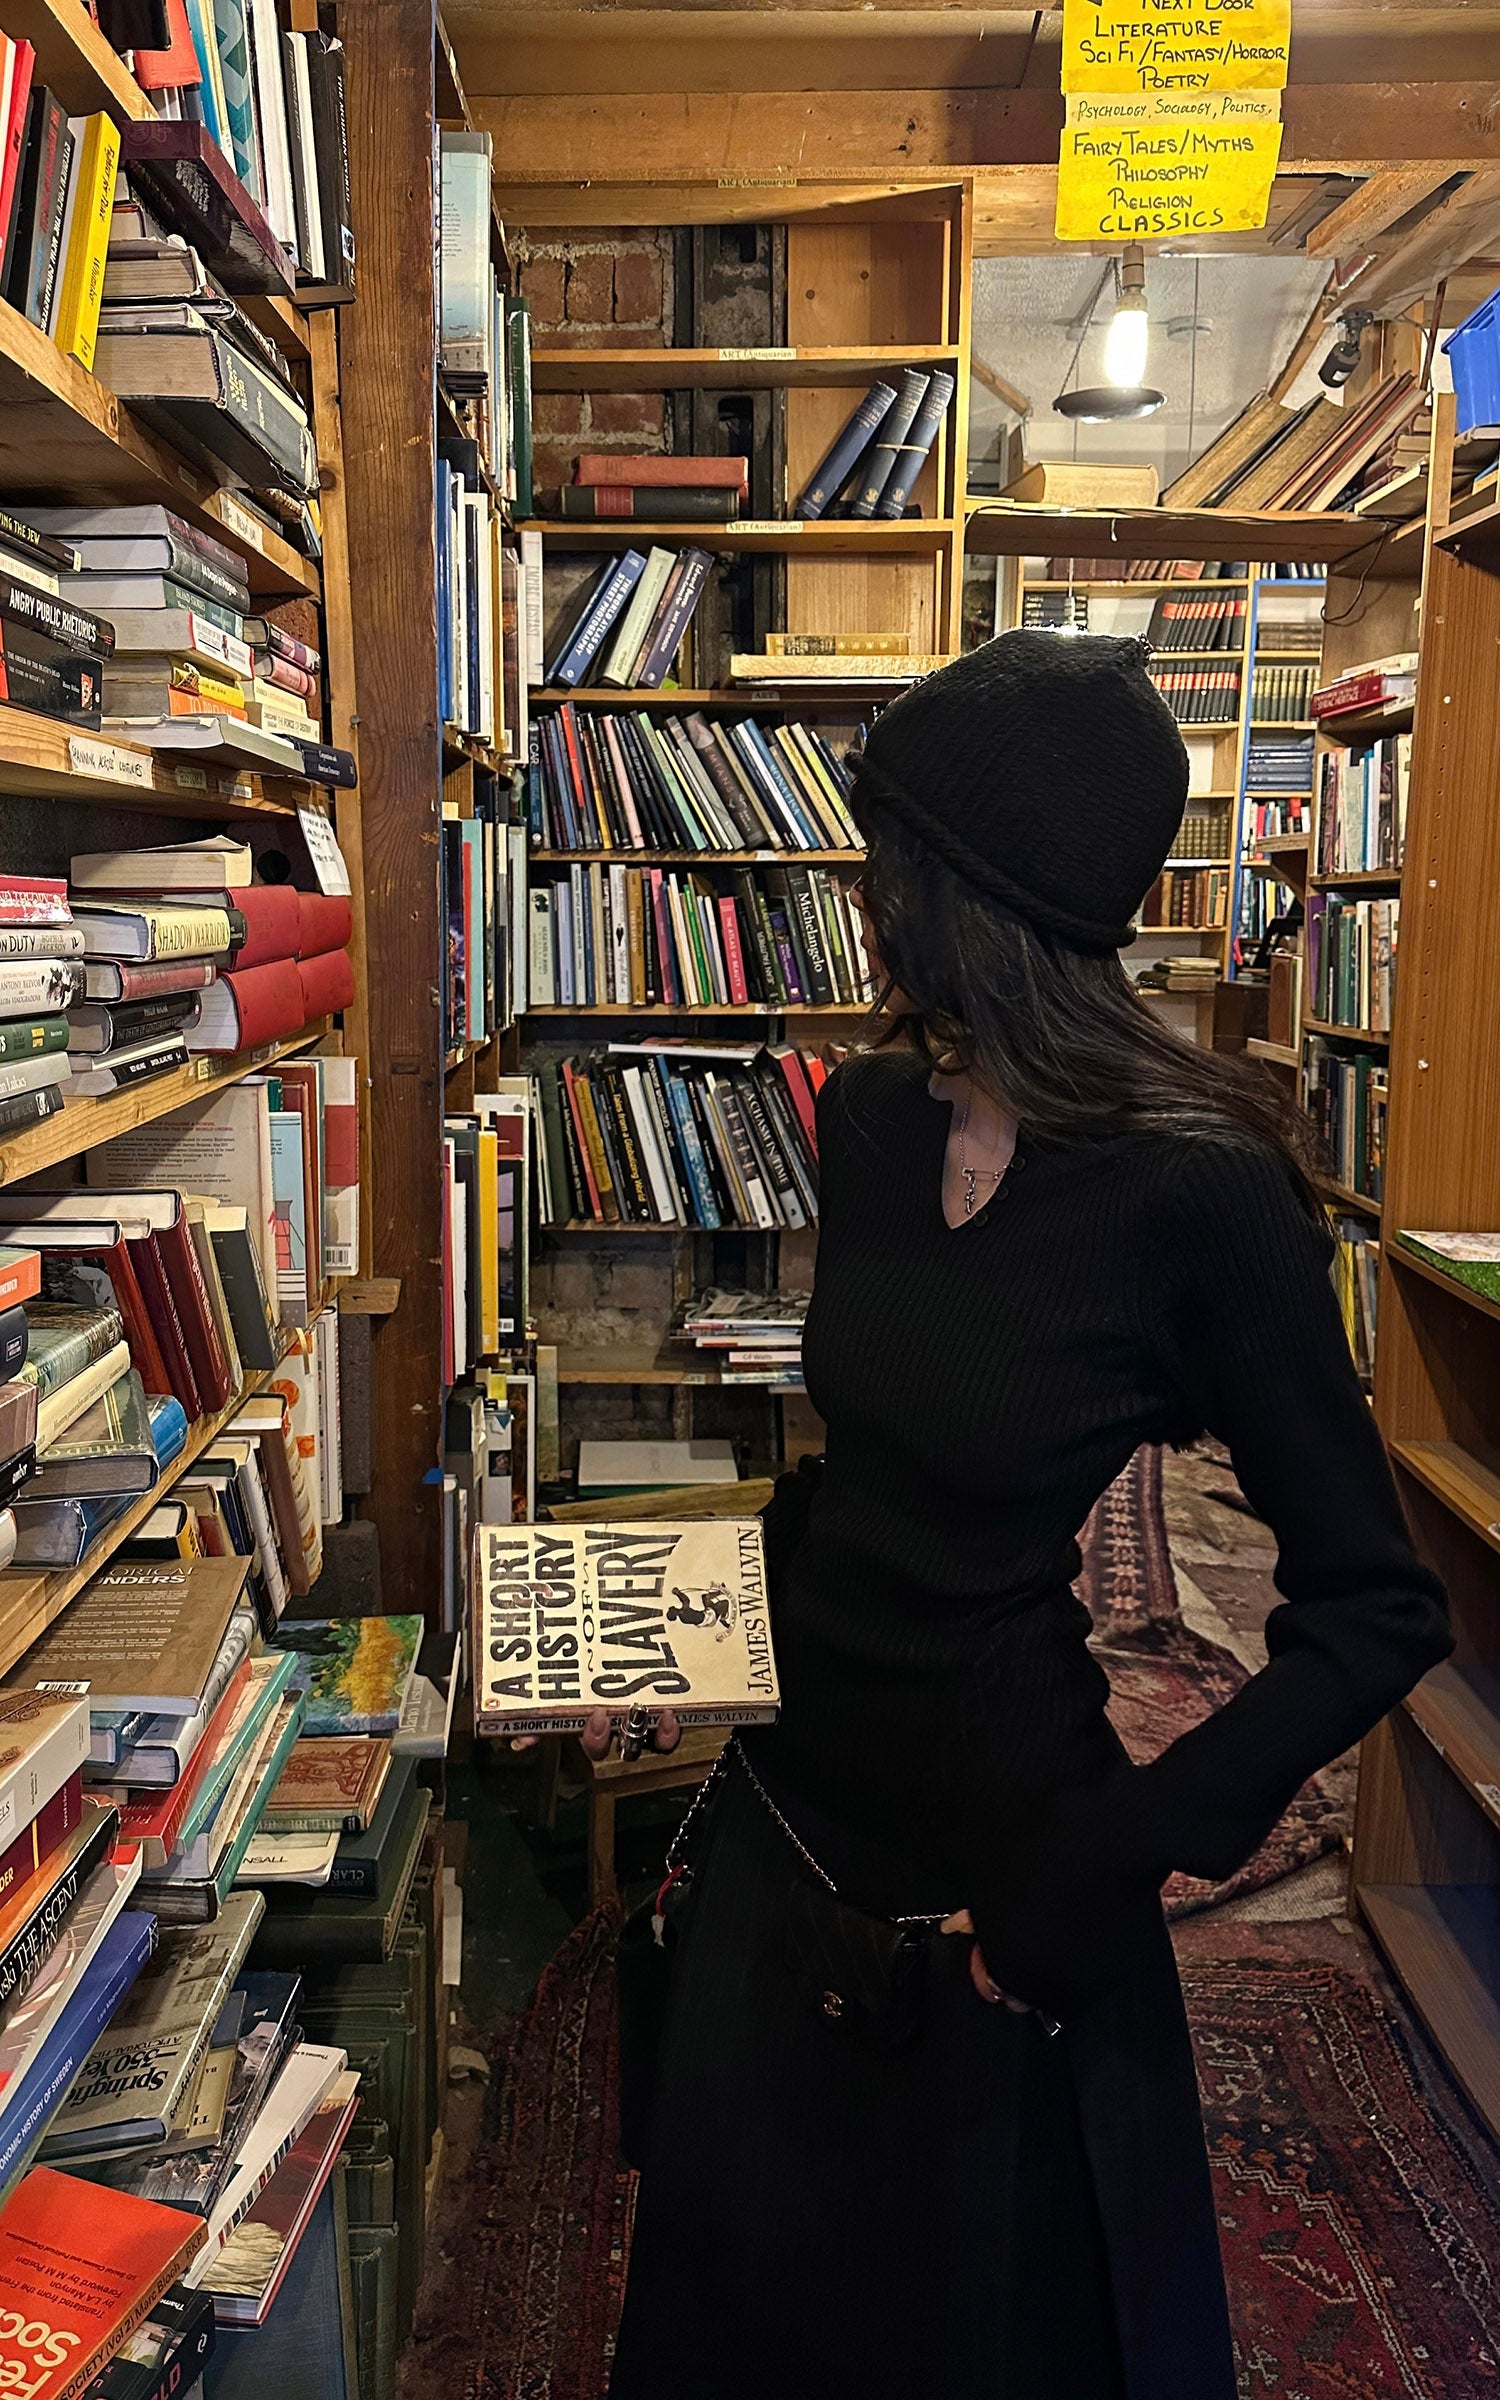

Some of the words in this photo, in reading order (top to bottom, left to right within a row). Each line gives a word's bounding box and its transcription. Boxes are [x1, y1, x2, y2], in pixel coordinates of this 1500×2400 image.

[1095, 15, 1222, 37] LITERATURE
[1137, 66, 1209, 89] POETRY
[339, 102, 348, 155] MODERN
[1108, 158, 1209, 182] PHILOSOPHY
[1108, 187, 1193, 210] RELIGION
[1099, 208, 1224, 233] CLASSICS
[606, 572, 626, 602] STREET
[620, 578, 633, 595] THE
[9, 587, 35, 616] ANGRY
[35, 598, 61, 628] PUBLIC
[61, 611, 97, 643] RHETORICS
[610, 593, 624, 614] WORLD
[575, 602, 608, 657] PHOTOGRAPHY
[594, 615, 612, 643] ATLAS
[9, 935, 36, 953] DUTY
[157, 924, 193, 952] SHADOW
[194, 922, 230, 947] WARRIORS
[799, 892, 825, 973] Michelangelo
[38, 942, 66, 952] JACKSON
[727, 928, 735, 950] ATLAS
[731, 960, 742, 987] BEAUTY
[613, 1093, 623, 1112] Tales
[617, 1112, 627, 1133] from
[750, 1100, 770, 1143] CHASM
[771, 1155, 790, 1184] TIME
[623, 1137, 640, 1179] Globalizing
[634, 1179, 647, 1202] World
[90, 1575, 187, 1586] UNDERS
[108, 1566, 198, 1577] ORICAL
[737, 1526, 764, 1620] WALVIN
[489, 1532, 533, 1663] SHORT
[533, 1531, 582, 1700] HISTORY
[582, 1588, 595, 1643] OF
[584, 1530, 692, 1700] SLAVERY
[740, 1617, 775, 1695] JAMES
[490, 1672, 533, 1700] A
[502, 1720, 511, 1732] A
[513, 1719, 549, 1731] SHORT
[675, 1712, 709, 1723] AMES
[710, 1711, 758, 1722] WALVIN
[332, 1868, 365, 1880] CLAR
[14, 1929, 41, 1972] THE
[36, 1870, 79, 1943] ASCENT
[21, 2099, 44, 2138] HISTORY
[43, 2087, 52, 2104] OF
[51, 2056, 74, 2093] SWEDEN
[185, 2232, 204, 2259] RKP
[15, 2255, 44, 2273] Postan
[35, 2289, 59, 2301] from
[49, 2280, 87, 2300] Manyon
[82, 2278, 125, 2299] Foreword
[57, 2296, 106, 2319] Translated
[0, 2307, 81, 2368] Soc
[59, 2352, 106, 2400] SOCIETY
[135, 2288, 158, 2321] Marc
[157, 2261, 181, 2293] Bloch
[0, 2359, 53, 2400] Fe
